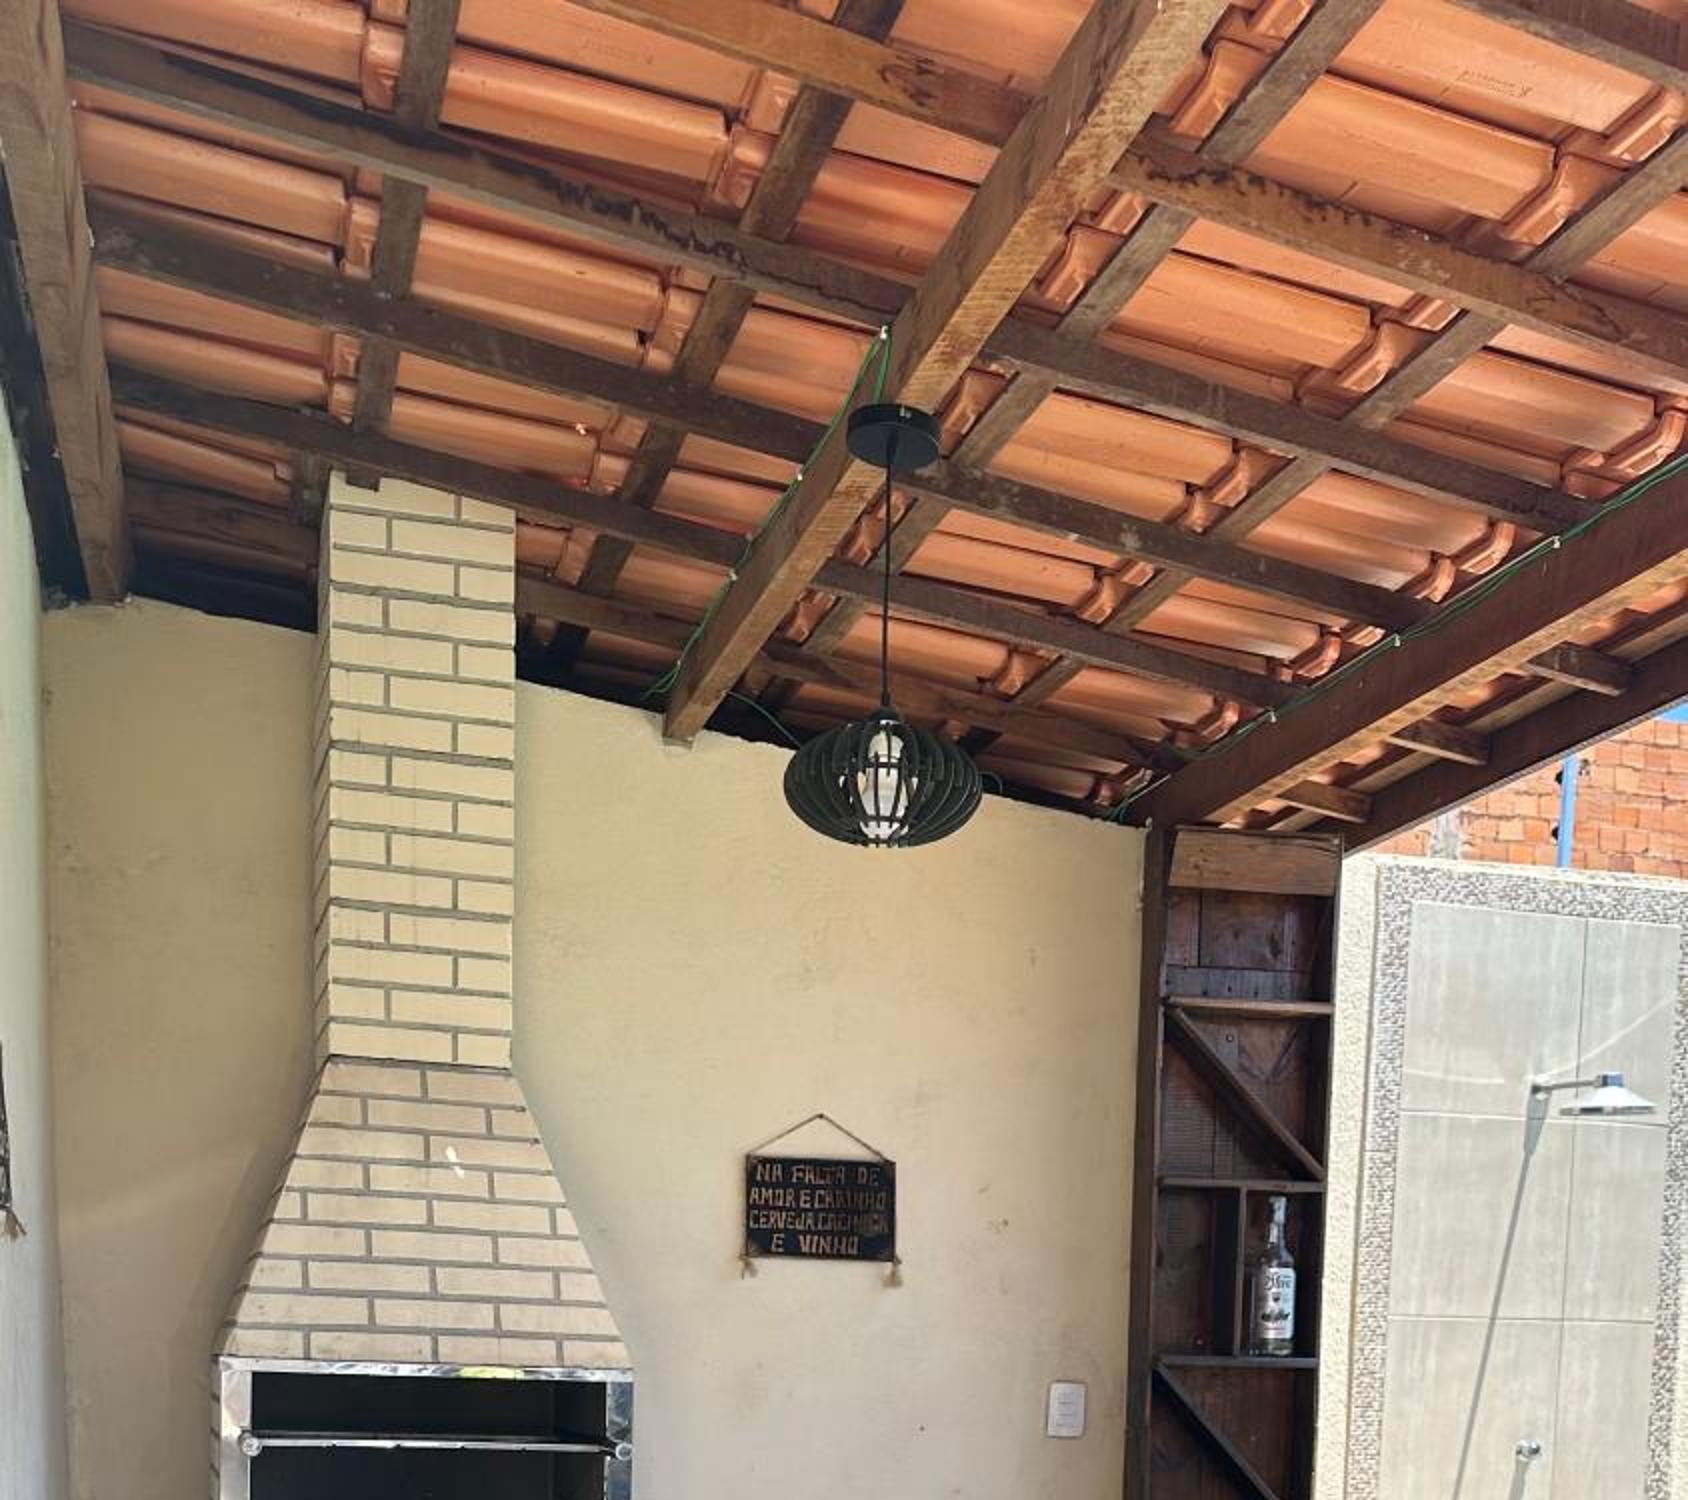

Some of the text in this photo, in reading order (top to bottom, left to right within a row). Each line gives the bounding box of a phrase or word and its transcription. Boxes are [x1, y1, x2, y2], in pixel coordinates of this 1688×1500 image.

[756, 1163, 881, 1186] NA FALTA DE
[750, 1187, 796, 1207] AMOR
[799, 1189, 812, 1208] E
[771, 1233, 859, 1255] E VINHO
